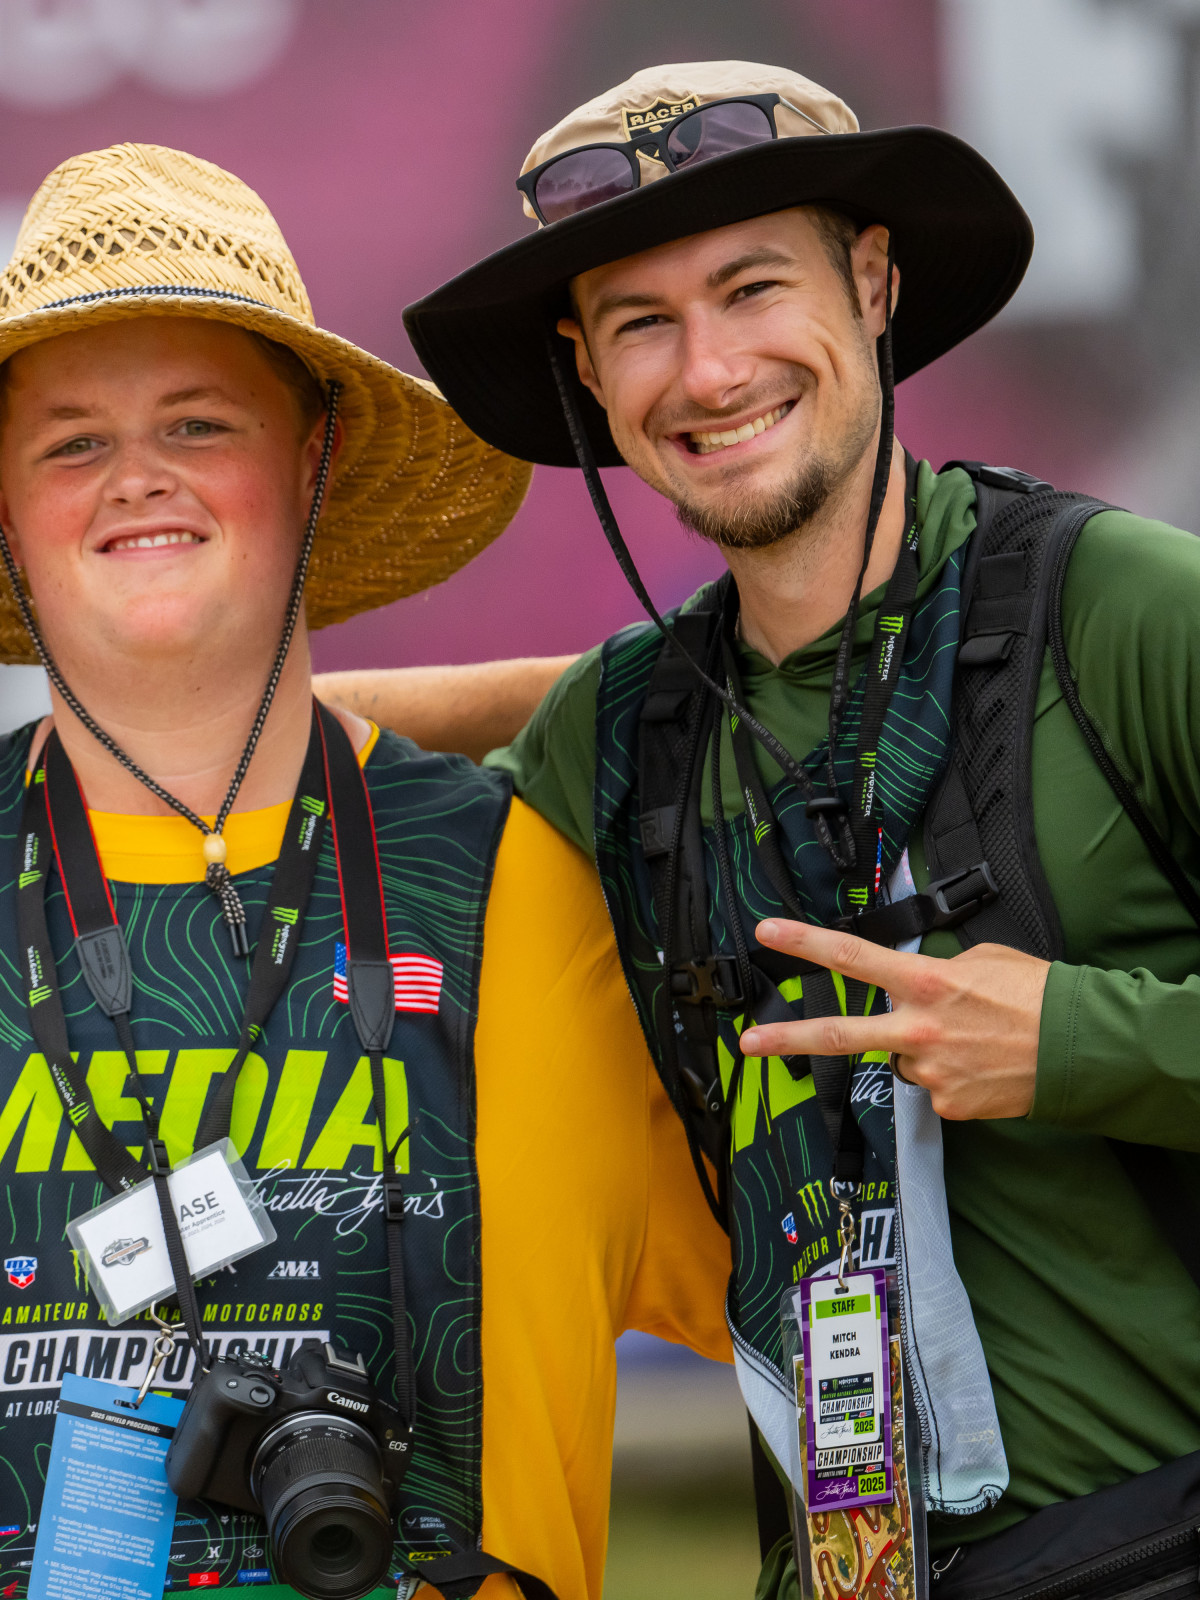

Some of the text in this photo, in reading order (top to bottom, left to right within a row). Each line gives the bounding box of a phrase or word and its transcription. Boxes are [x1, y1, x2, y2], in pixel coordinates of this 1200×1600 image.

[629, 103, 695, 126] RACER
[881, 635, 895, 681] MONSTER
[864, 771, 875, 817] MONSTER
[301, 814, 317, 851] MONSTER
[275, 924, 291, 965] MONSTER
[52, 1064, 75, 1107] MONSTER
[179, 1190, 220, 1223] ASE
[191, 1209, 226, 1229] Apprentice
[267, 1260, 321, 1279] AMA
[2, 1302, 88, 1325] AMATEUR
[203, 1302, 324, 1322] MOTOCROSS
[831, 1299, 856, 1314] STAFF
[832, 1331, 857, 1344] MITCH
[829, 1347, 861, 1360] KENDRA
[6, 1400, 60, 1418] AT LORE
[327, 1391, 370, 1413] Canon
[821, 1395, 873, 1415] CHAMPIONSHIP
[854, 1420, 874, 1433] 2025
[388, 1440, 408, 1452] EOS
[817, 1444, 882, 1467] CHAMPIONSHIP
[860, 1476, 884, 1493] 2025
